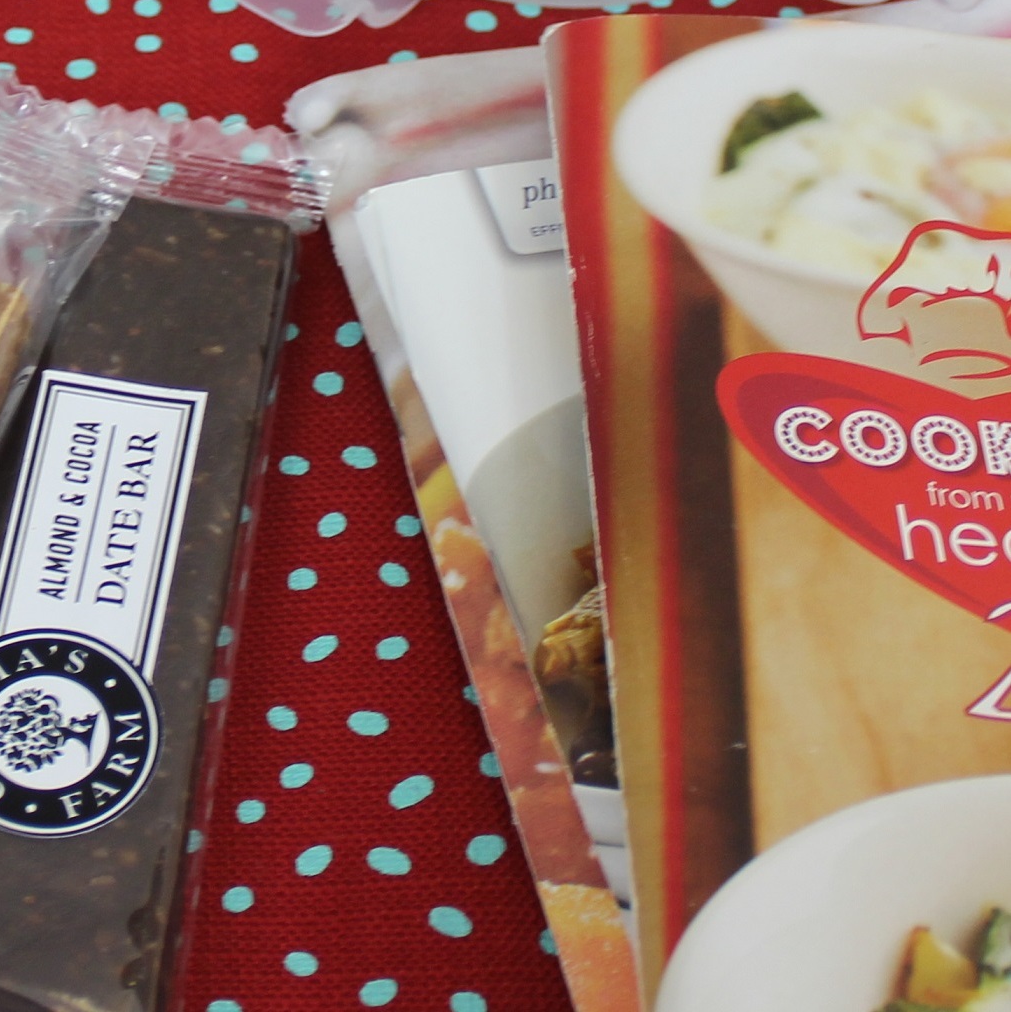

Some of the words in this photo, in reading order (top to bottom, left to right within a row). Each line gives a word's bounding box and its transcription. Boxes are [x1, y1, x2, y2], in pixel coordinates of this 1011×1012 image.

[62, 421, 103, 485] COCOA
[117, 430, 161, 502] BAR
[60, 493, 87, 506] &
[925, 480, 1005, 512] from
[37, 514, 81, 601] ALMOND
[94, 507, 143, 608] DATE
[896, 504, 1011, 567] he
[59, 711, 145, 820] FARM
